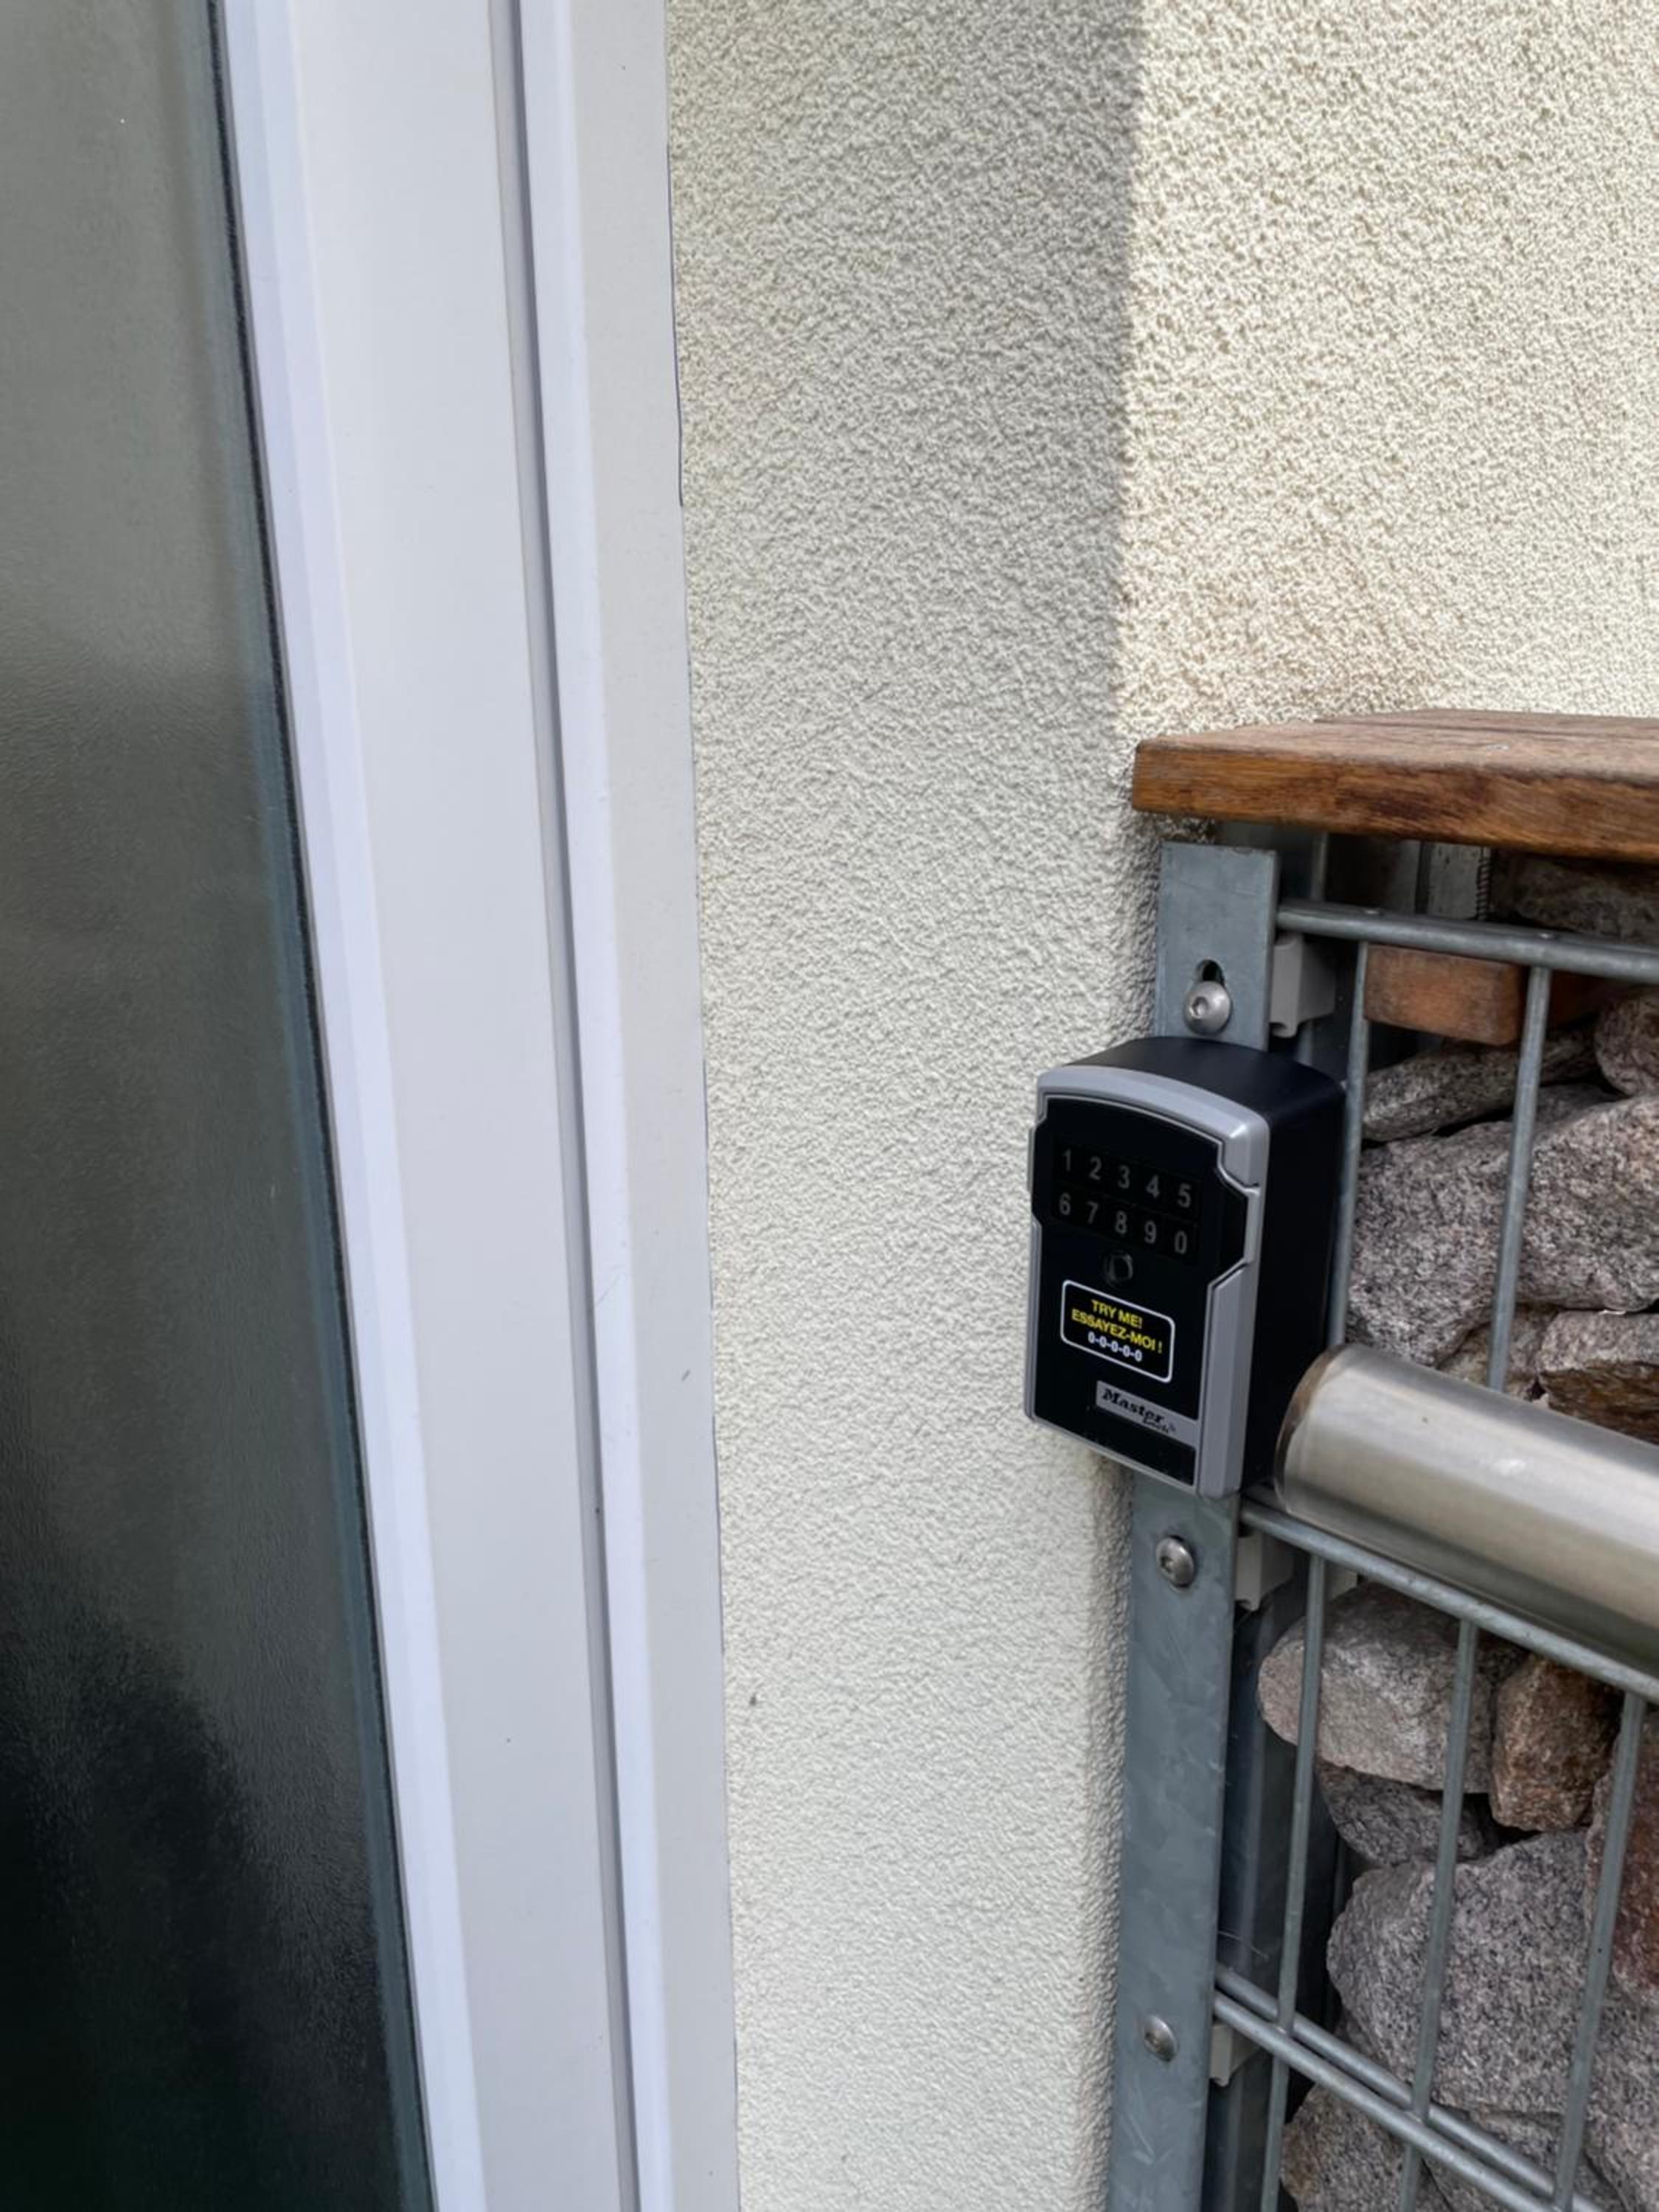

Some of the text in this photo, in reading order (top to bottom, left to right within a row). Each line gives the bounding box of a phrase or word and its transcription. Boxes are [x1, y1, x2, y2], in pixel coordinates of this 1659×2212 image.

[1062, 1149, 1192, 1208] 1 2 3 4 5
[1059, 1192, 1188, 1254] 6 7 8 9 0
[1091, 1299, 1143, 1329] TRY ME!
[1088, 1331, 1143, 1363] 0-0-0-0-0
[1102, 1388, 1166, 1424] Master
